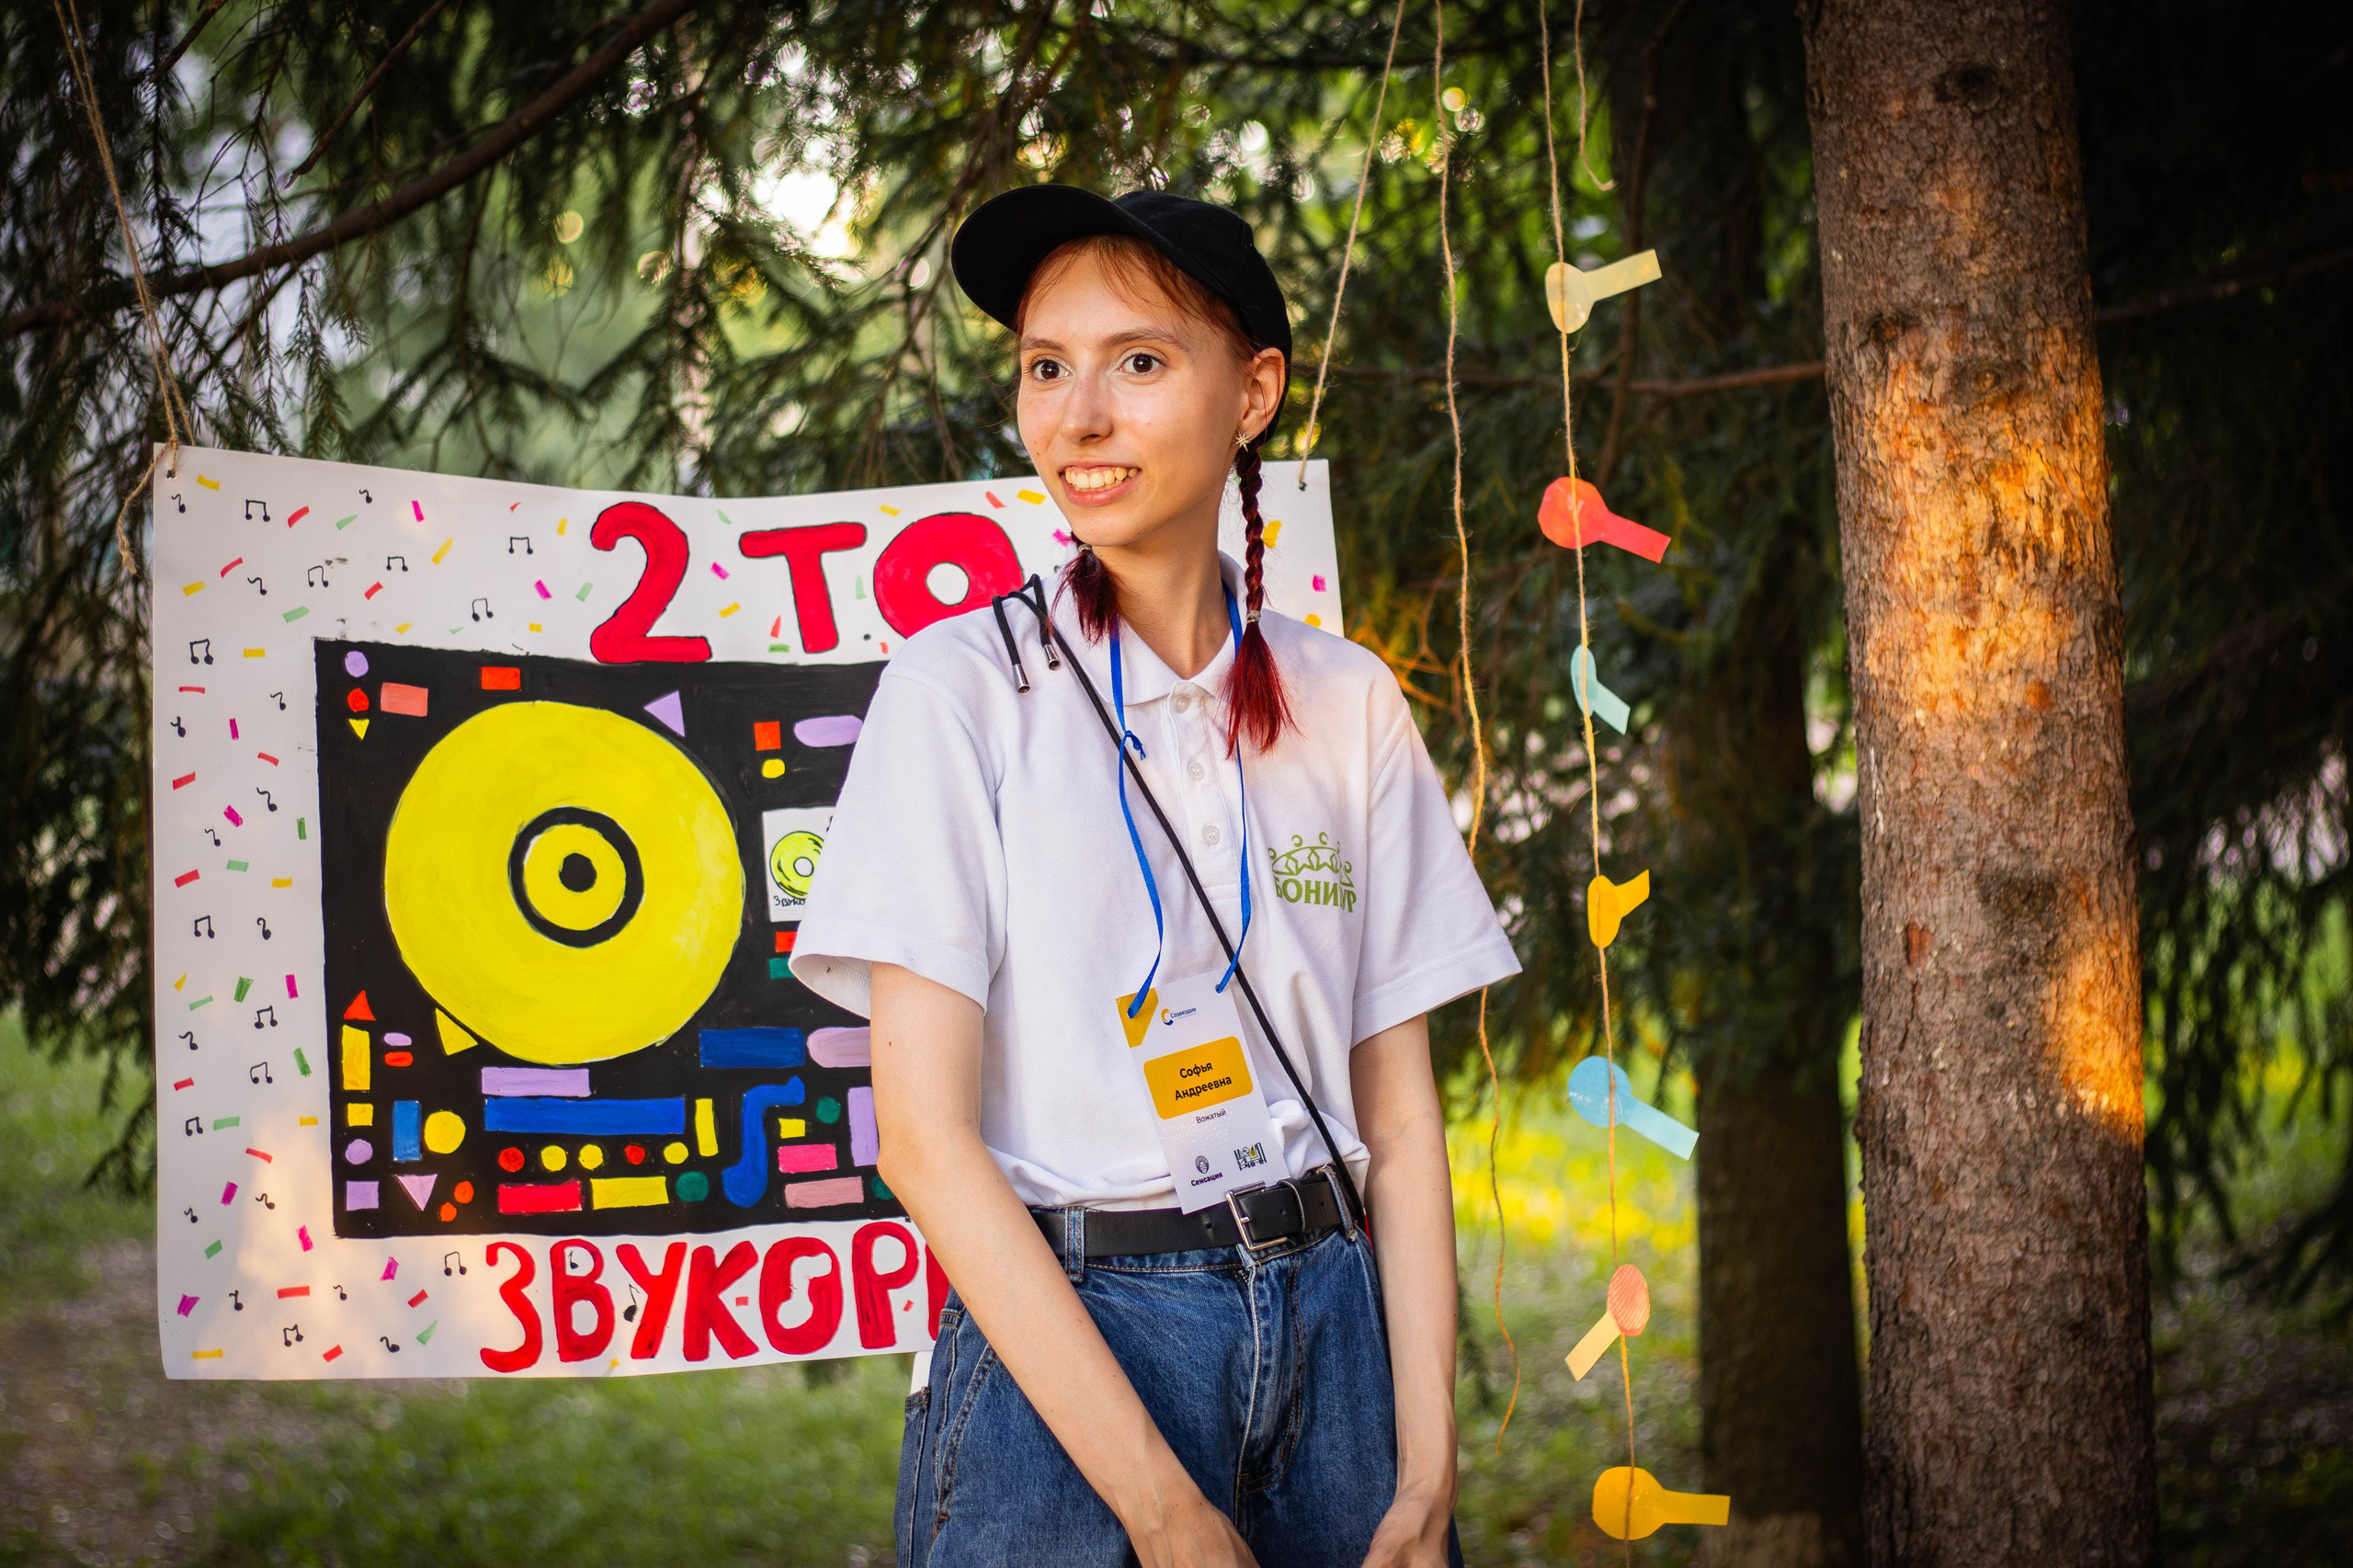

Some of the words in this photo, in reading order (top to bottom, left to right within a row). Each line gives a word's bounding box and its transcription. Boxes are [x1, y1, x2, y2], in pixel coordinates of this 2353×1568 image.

[591, 501, 712, 664] 2
[1179, 1062, 1213, 1078] Софья
[1176, 1076, 1233, 1100] Андреевна
[1196, 1108, 1226, 1123] Вожатый
[1190, 1172, 1223, 1187] Сенсация
